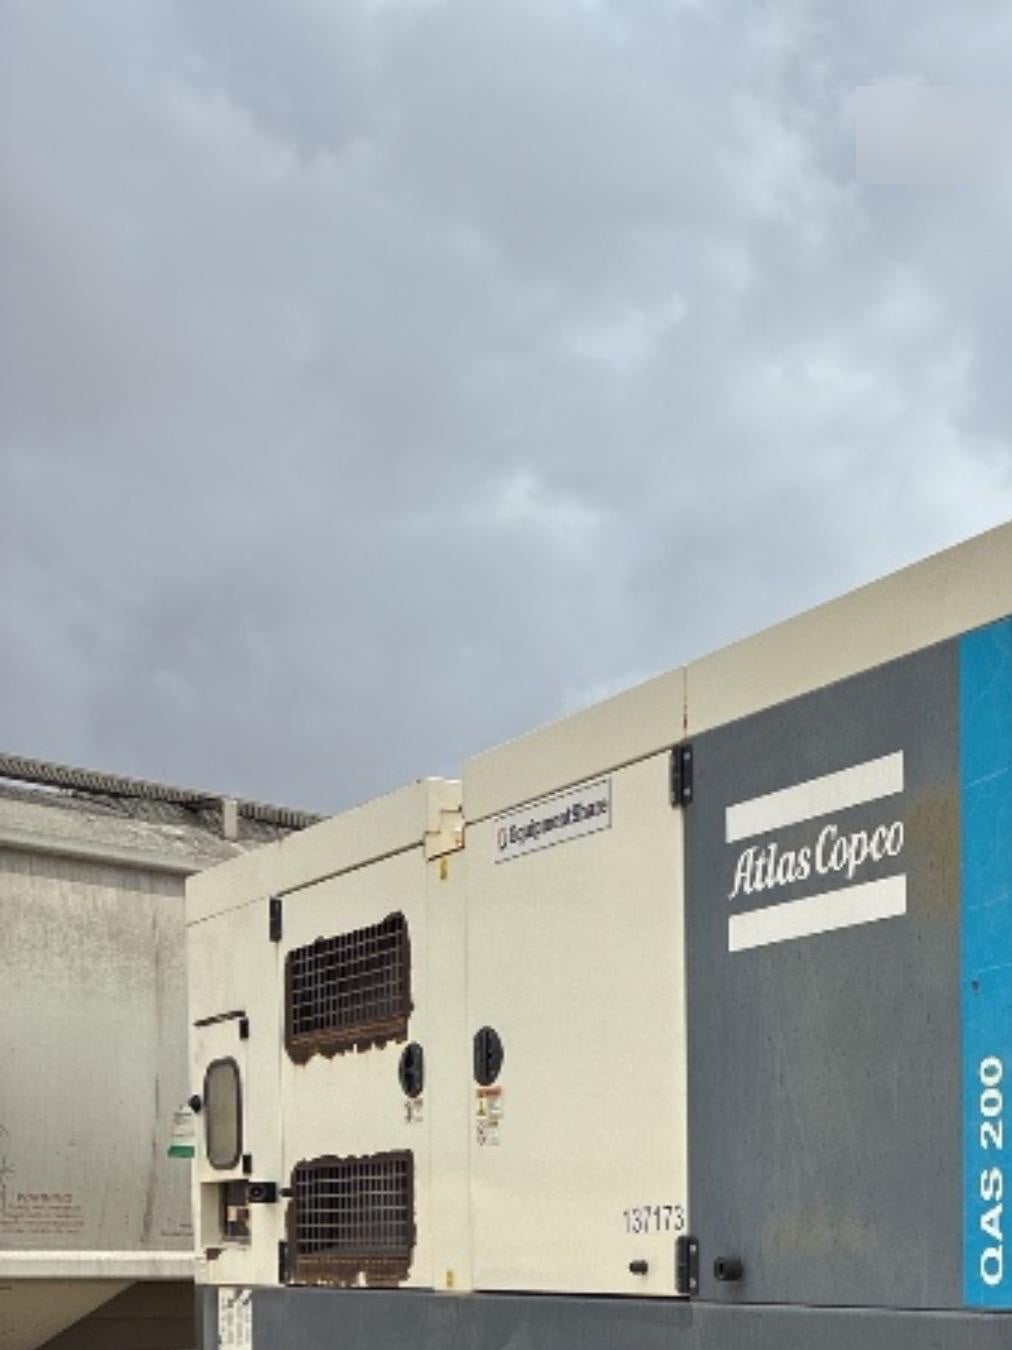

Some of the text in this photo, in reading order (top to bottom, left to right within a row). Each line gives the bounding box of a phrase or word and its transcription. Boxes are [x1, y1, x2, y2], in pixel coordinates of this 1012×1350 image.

[728, 821, 904, 900] Atlas Copco
[980, 1056, 1003, 1286] QAS 200
[623, 1204, 684, 1233] 137173
